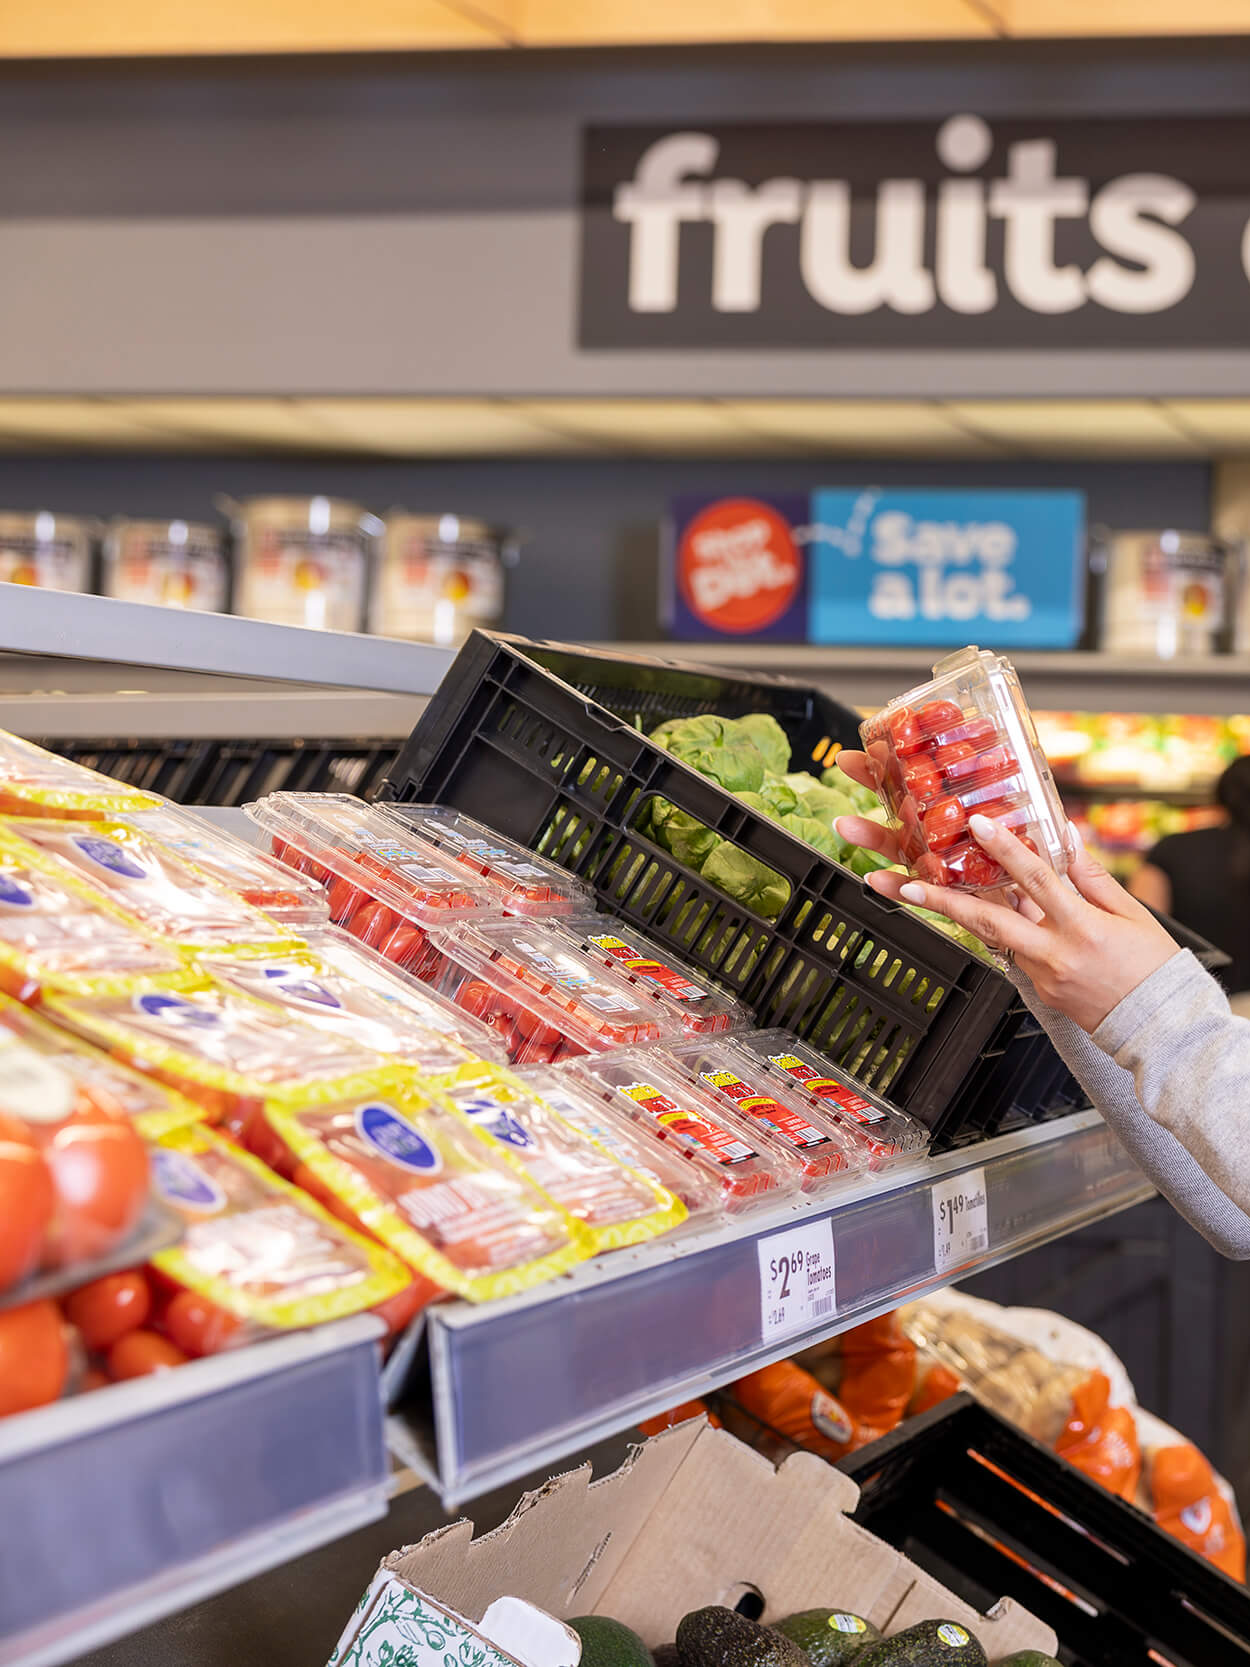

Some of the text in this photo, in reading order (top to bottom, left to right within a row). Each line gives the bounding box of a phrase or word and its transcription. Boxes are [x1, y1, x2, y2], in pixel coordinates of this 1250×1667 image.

[614, 113, 1196, 316] fruits
[870, 511, 1017, 566] Save
[869, 566, 1032, 622] a lot.
[806, 1251, 821, 1268] Grape
[806, 1265, 832, 1286] Tomatoes
